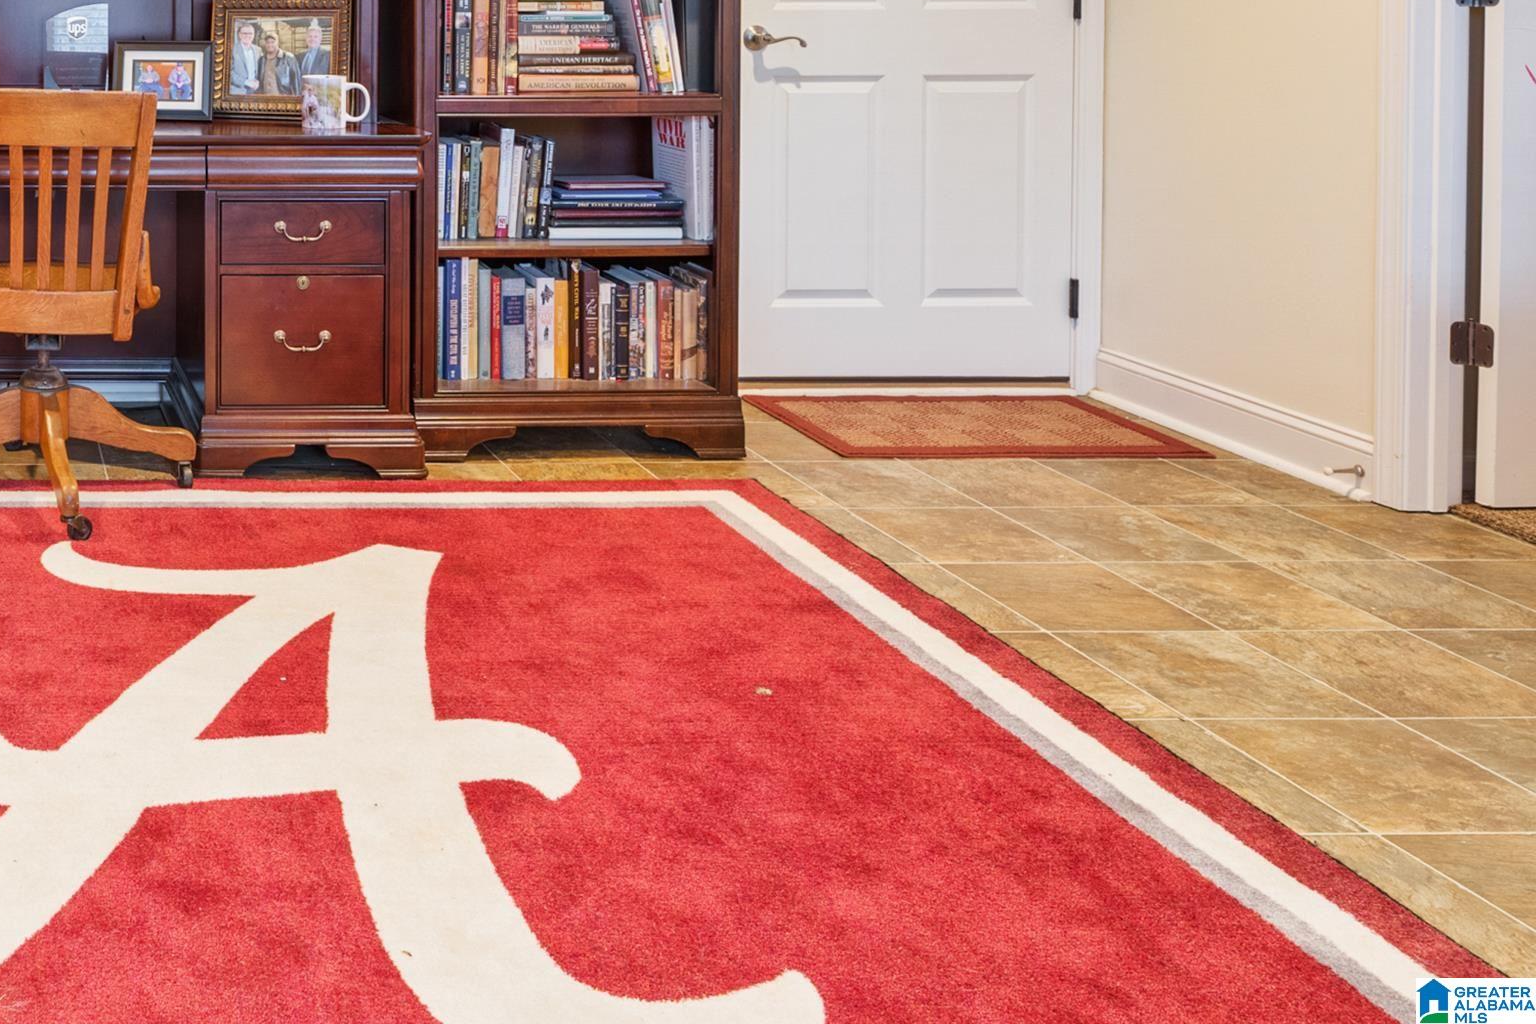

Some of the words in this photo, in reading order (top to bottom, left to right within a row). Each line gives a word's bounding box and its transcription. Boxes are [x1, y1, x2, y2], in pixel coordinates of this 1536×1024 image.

[68, 23, 88, 36] ups
[656, 117, 686, 138] CIVIL
[658, 133, 686, 149] WAR
[450, 335, 458, 343] THE
[450, 344, 458, 355] CIVIL
[449, 356, 458, 365] WAR
